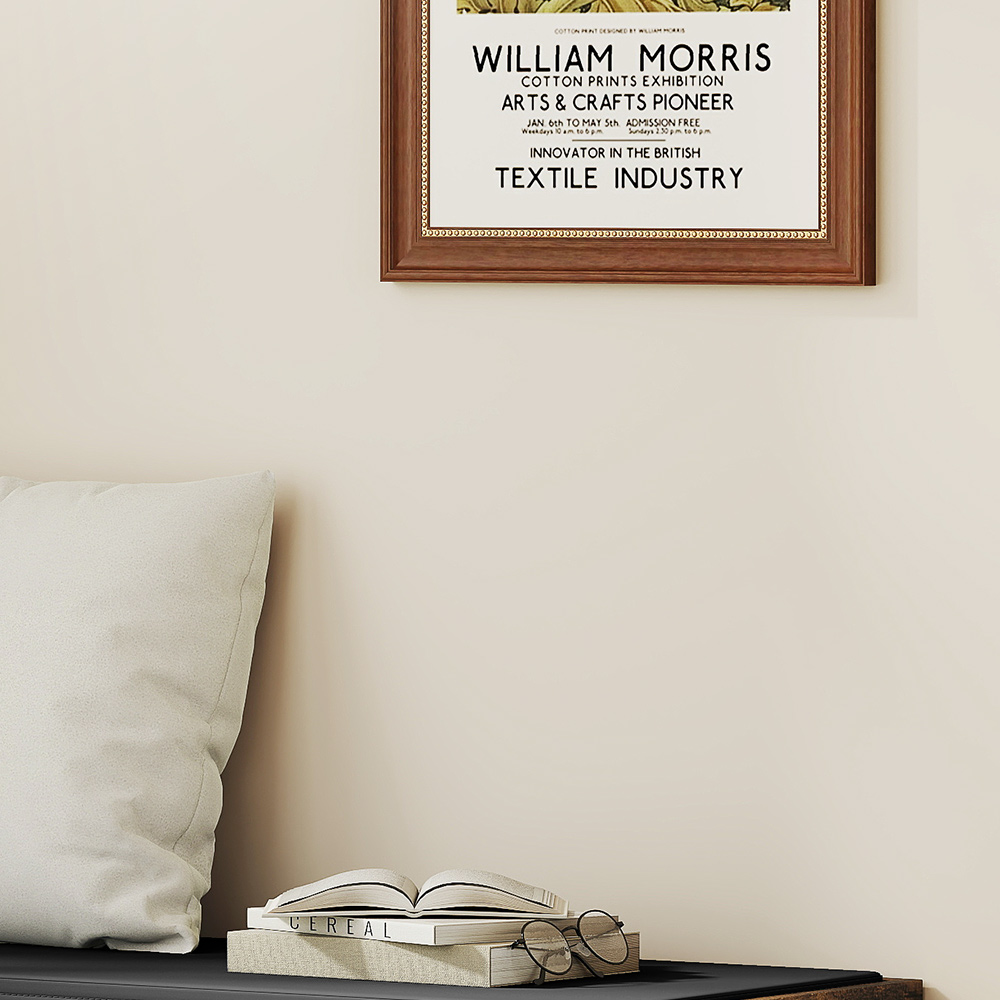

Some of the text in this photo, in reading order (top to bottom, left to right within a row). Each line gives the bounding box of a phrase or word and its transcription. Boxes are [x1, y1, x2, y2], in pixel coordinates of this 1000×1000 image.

[473, 43, 772, 73] WILLIAM MORRIS
[521, 74, 724, 88] COTTON PRINTS EXHIBITION
[501, 93, 734, 112] ARTS & CRAFTS PIONEER
[548, 119, 564, 128] 6th
[566, 119, 580, 128] TO
[582, 118, 602, 127] MAY
[625, 118, 701, 128] ADMISSION FREE
[521, 128, 553, 136] Weekdays
[530, 147, 701, 159] INNOVATOR IN THE BRITISH
[495, 167, 744, 190] TEXTILE INDUSTRY
[289, 916, 391, 939] CEREAL
